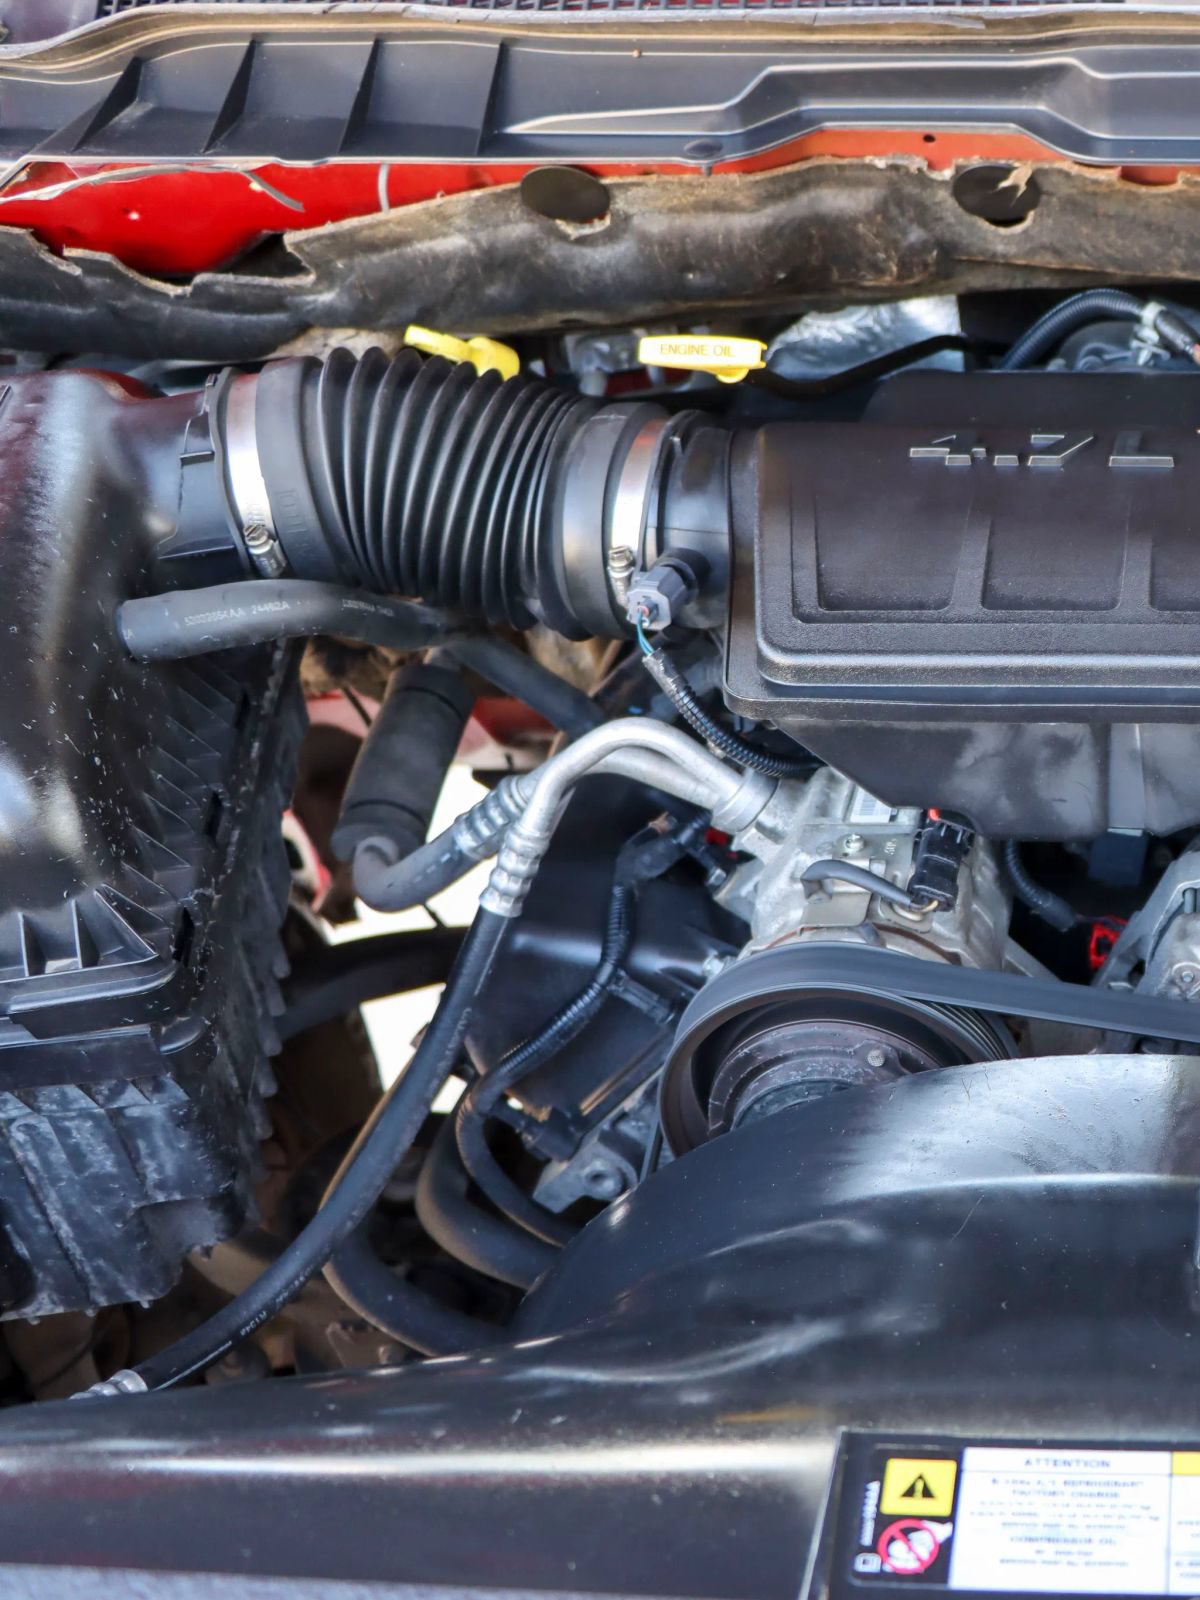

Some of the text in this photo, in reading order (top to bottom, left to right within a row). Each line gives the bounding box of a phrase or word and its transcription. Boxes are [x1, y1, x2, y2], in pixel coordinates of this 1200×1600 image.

[660, 343, 735, 357] ENGINE OIL
[909, 432, 1175, 467] 4.7L
[1024, 1457, 1111, 1468] ATTENTION
